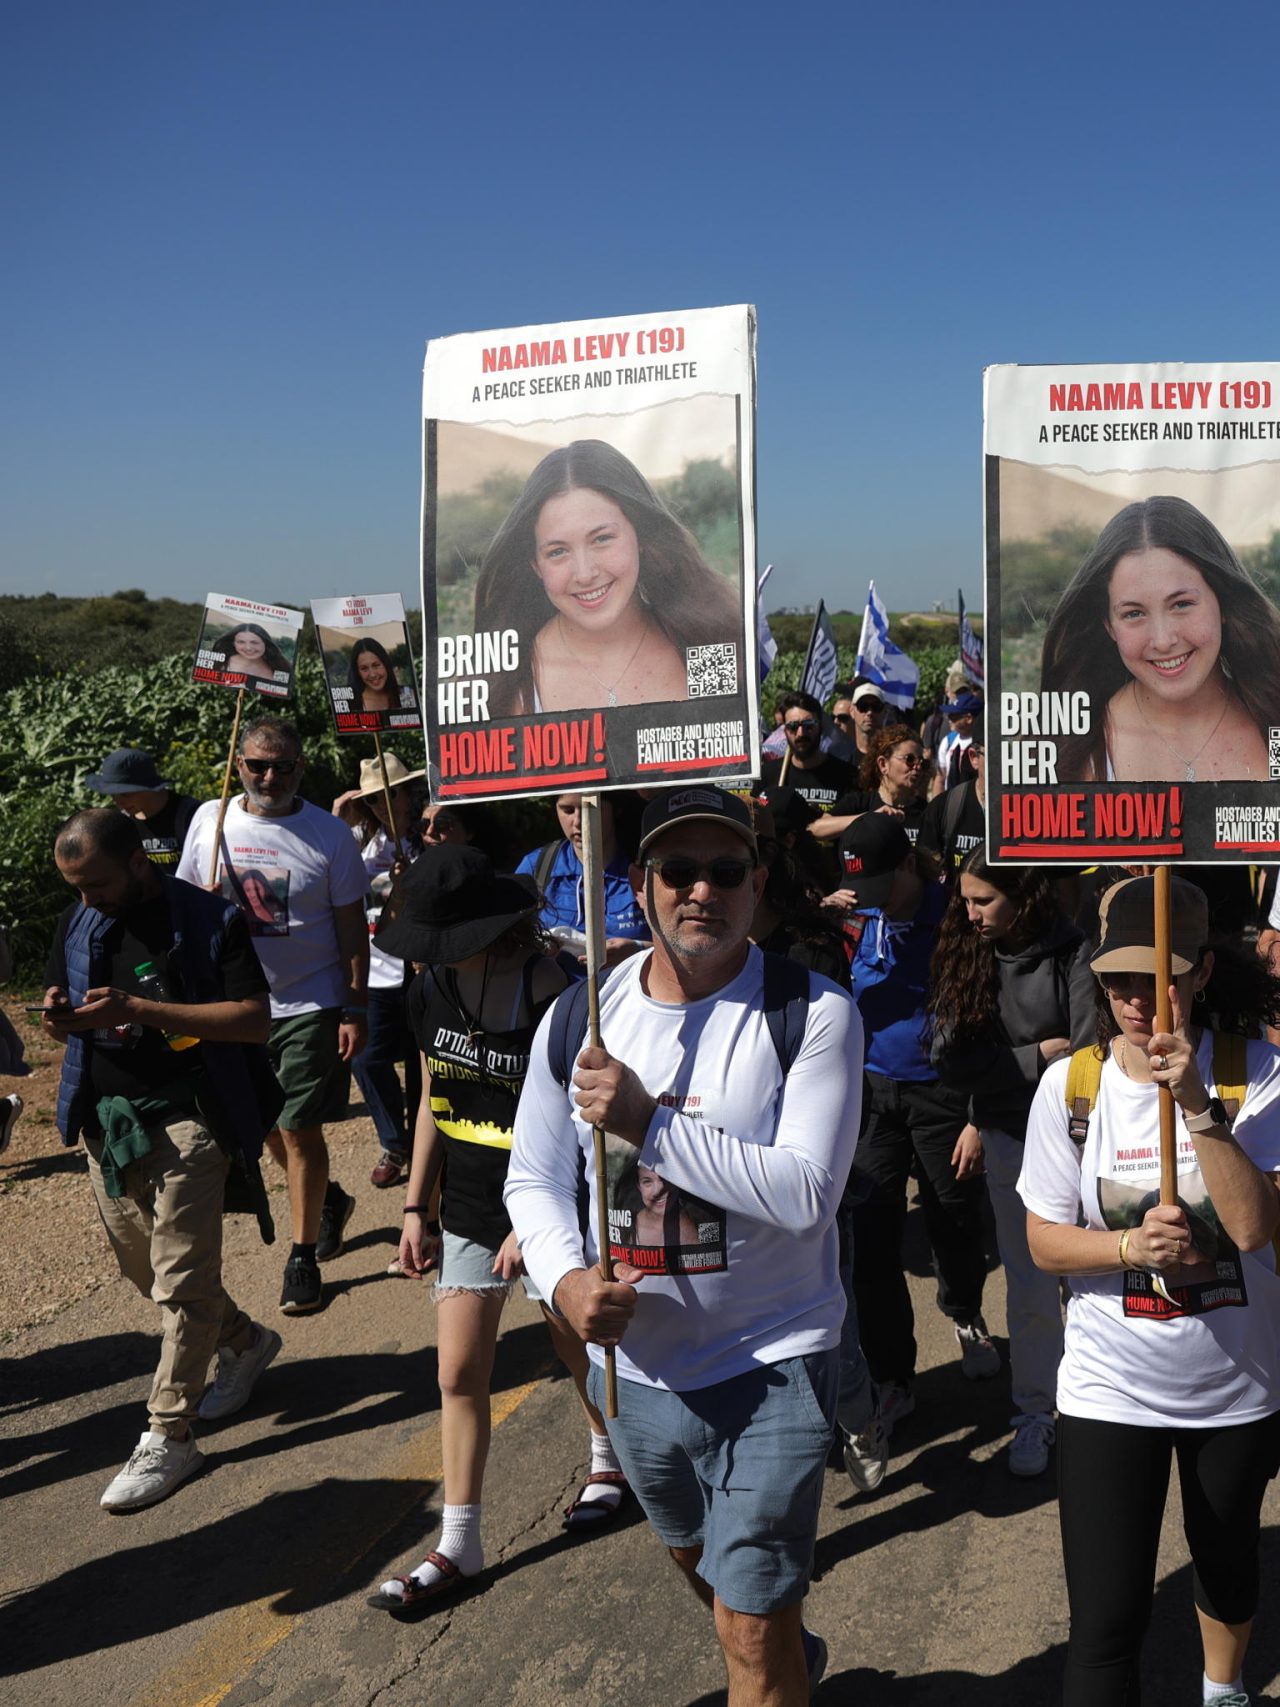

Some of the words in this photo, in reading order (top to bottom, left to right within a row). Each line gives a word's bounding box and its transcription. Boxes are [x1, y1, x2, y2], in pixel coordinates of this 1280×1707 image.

[482, 339, 567, 373] NAAMA
[574, 332, 630, 362] LEVY
[636, 327, 684, 355] (19)
[472, 386, 480, 403] A
[484, 380, 526, 401] PEACE
[530, 374, 580, 395] SEEKER
[584, 370, 612, 388] AND
[616, 362, 697, 386] TRIATHLETE
[1050, 383, 1143, 411] NAAMA
[1151, 382, 1212, 410] LEVY
[1220, 380, 1271, 409] (19)
[1039, 425, 1048, 443] A
[1053, 424, 1098, 442] PEACE
[1103, 422, 1158, 441] SEEKER
[1163, 422, 1193, 440] AND
[196, 658, 214, 669] HER
[198, 649, 226, 662] BRING
[438, 629, 519, 678] BRING
[331, 687, 354, 700] BRING
[438, 680, 490, 726] HER
[333, 700, 350, 712] HER
[1000, 691, 1090, 736] BRING
[637, 726, 682, 743] HOSTAGES
[684, 724, 701, 740] AND
[703, 720, 743, 738] MISSING
[439, 728, 516, 778] HOME
[523, 713, 605, 769] NOW!
[637, 742, 696, 764] FAMILIES
[699, 736, 744, 760] FORUM
[1001, 740, 1058, 785] HER
[1002, 793, 1086, 839] HOME
[1094, 786, 1184, 839] NOW!
[1216, 806, 1262, 822] HOSTAGES
[1215, 822, 1275, 843] FAMILIES
[658, 1096, 680, 1107] EVY
[1116, 1147, 1153, 1161] NAAMA
[1113, 1164, 1118, 1172] A
[1118, 1163, 1136, 1172] PEACE
[1138, 1162, 1158, 1170] SEEKER
[608, 1208, 632, 1228] RING
[608, 1225, 622, 1244] ER
[632, 1248, 665, 1267] NOW!
[1128, 1272, 1146, 1290] HER
